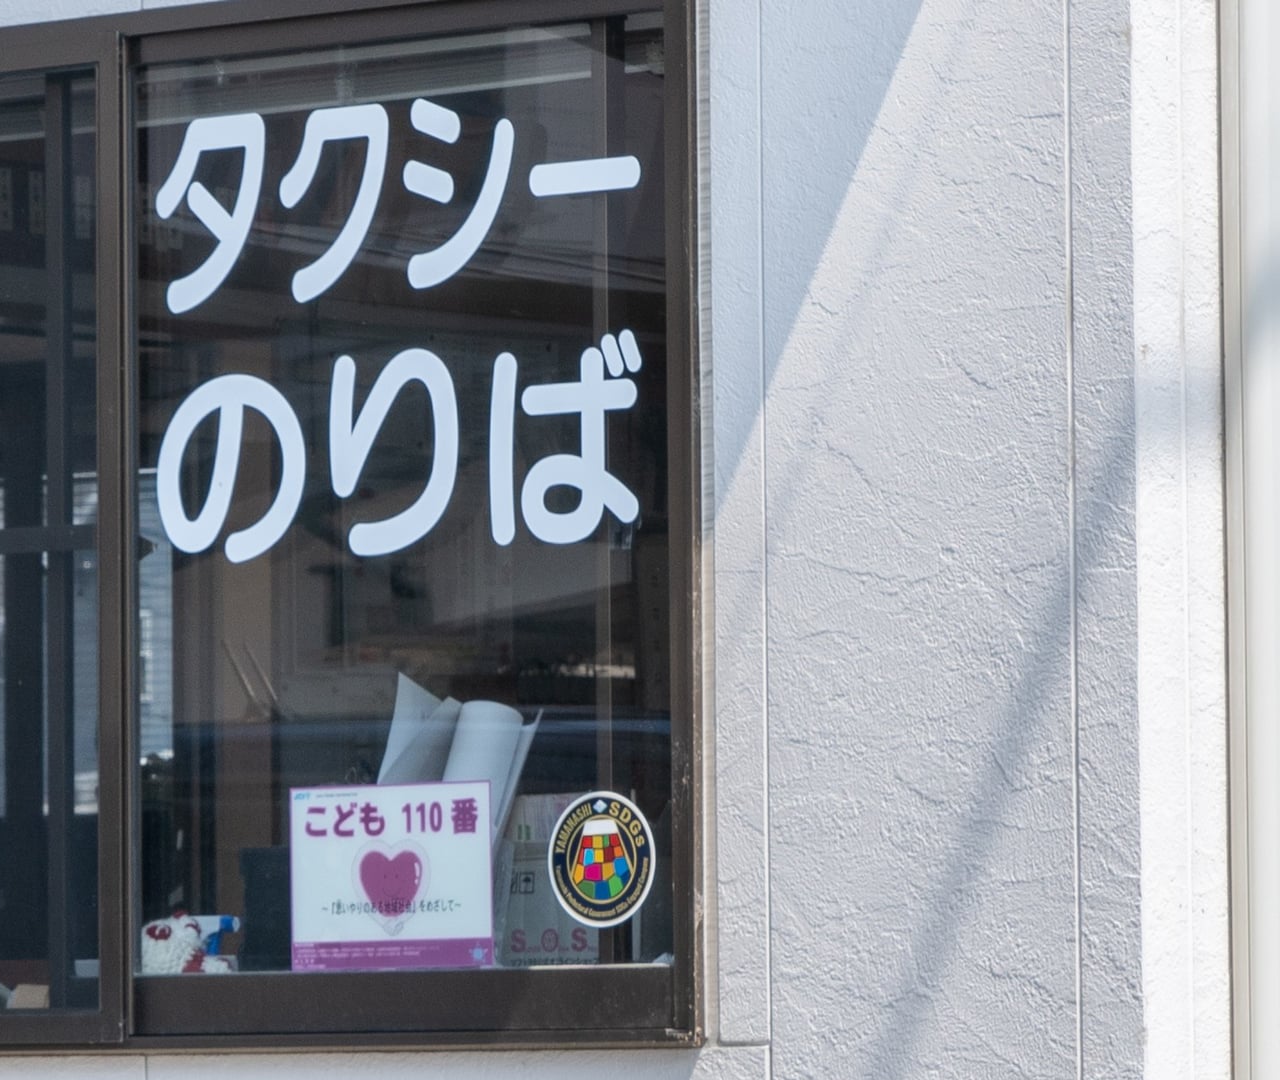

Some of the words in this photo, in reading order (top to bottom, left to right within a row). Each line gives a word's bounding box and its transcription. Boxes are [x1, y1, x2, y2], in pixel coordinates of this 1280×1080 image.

[154, 97, 642, 315] タクシー
[155, 328, 644, 564] のりば
[305, 801, 385, 838] こども
[401, 801, 443, 834] 110
[451, 797, 479, 835] 番
[555, 802, 593, 854] YAMANASHI
[608, 801, 646, 848] SDGs
